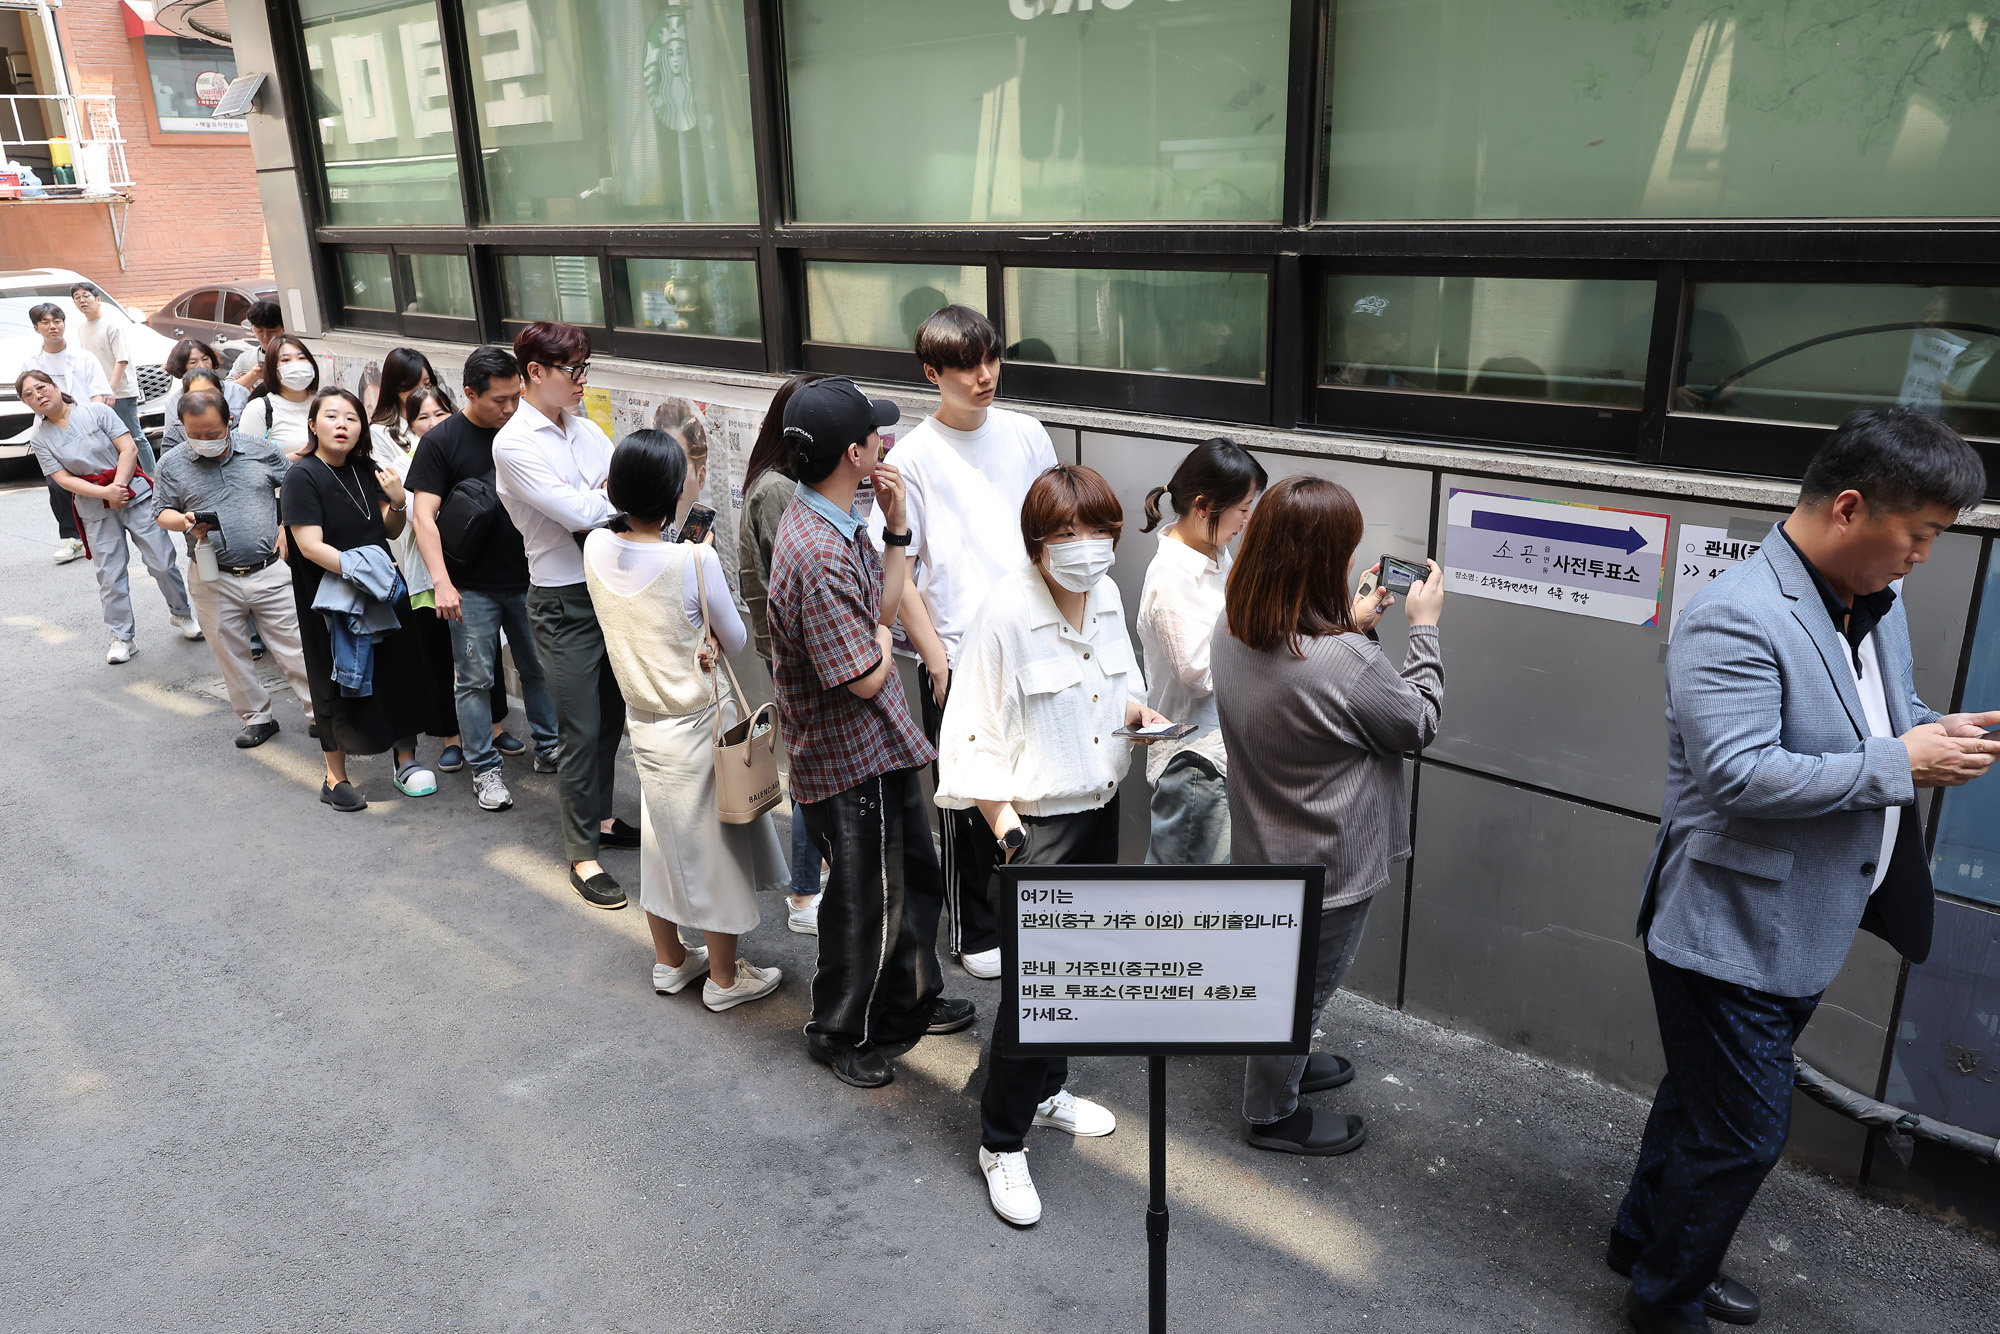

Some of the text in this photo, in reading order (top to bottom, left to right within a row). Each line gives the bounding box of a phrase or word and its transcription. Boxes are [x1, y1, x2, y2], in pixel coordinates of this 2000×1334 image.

[1553, 554, 1640, 583] 사전투표소
[1709, 568, 1726, 579] 4
[1547, 586, 1563, 600] 4층
[1571, 591, 1590, 605] 강당
[748, 780, 780, 804] BALENCAGA
[1021, 889, 1073, 904] 여기는
[1021, 913, 1298, 929] 관외(중구 거주 이외) 대기줄입니다.
[1021, 961, 1204, 976] 관내 거주민(중구민)은
[1021, 984, 1257, 999] 바로 투표소(주민센터 4층)로
[1021, 1006, 1079, 1022] 가세요.
